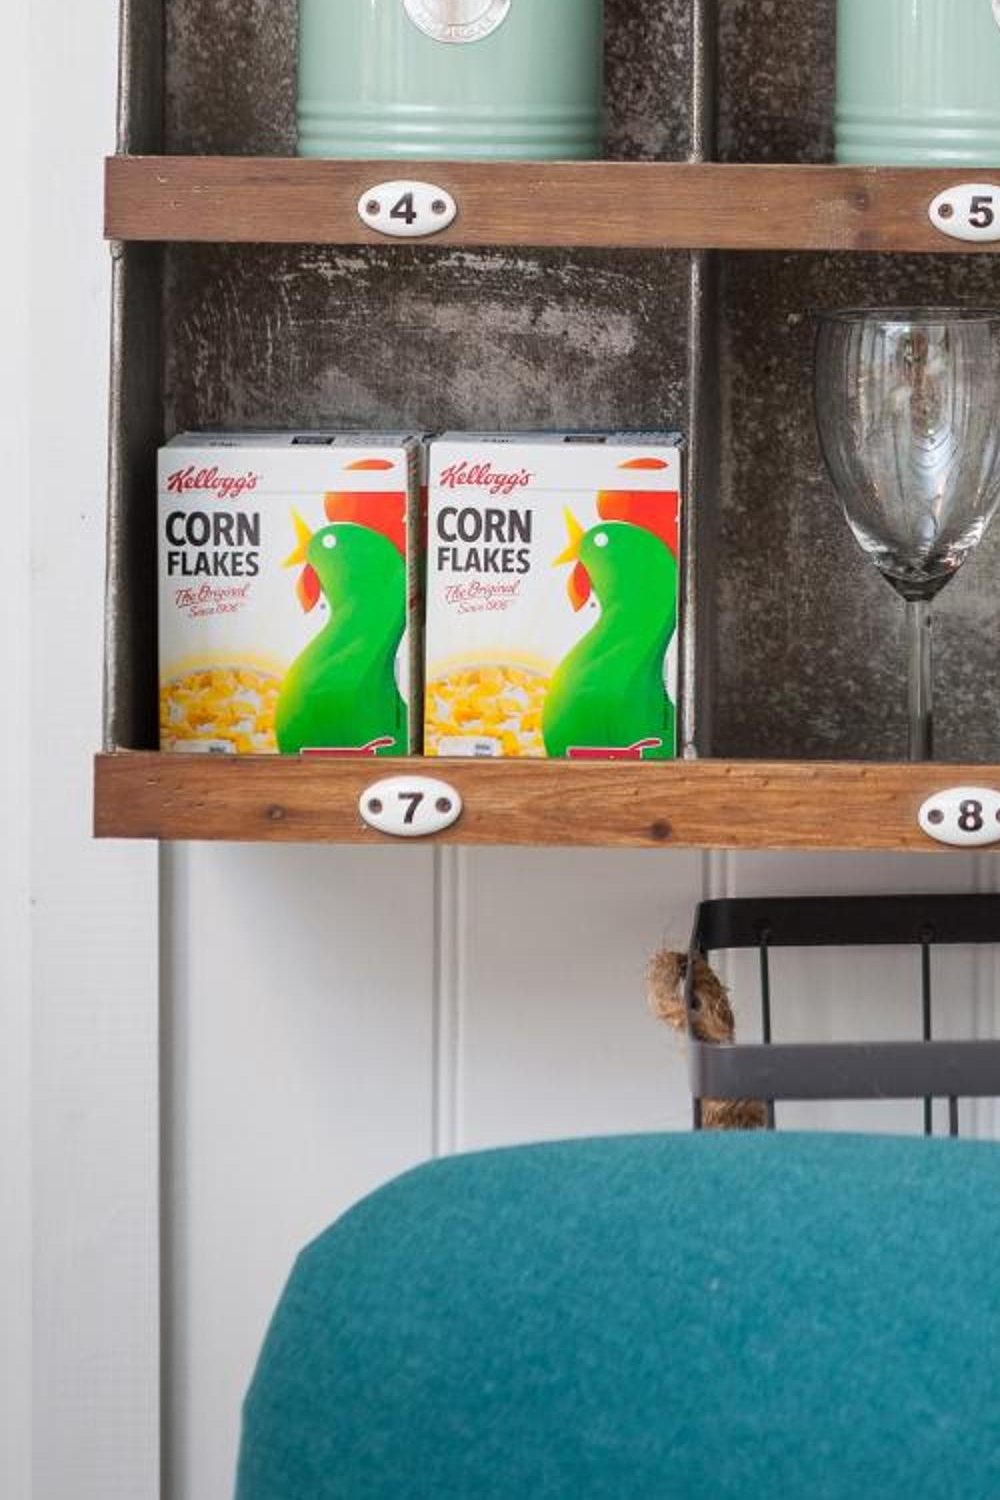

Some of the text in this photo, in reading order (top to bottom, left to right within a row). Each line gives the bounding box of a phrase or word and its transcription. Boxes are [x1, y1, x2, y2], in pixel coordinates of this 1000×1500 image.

[389, 194, 416, 225] 4
[968, 197, 993, 228] 5
[167, 465, 259, 499] Kellogg's
[440, 460, 532, 495] Kellogg's
[165, 510, 261, 547] CORN
[437, 507, 532, 543] CORN
[167, 551, 260, 578] FLAKES
[437, 547, 531, 574] FLAKES
[398, 793, 424, 824] 7
[957, 800, 984, 832] 8
